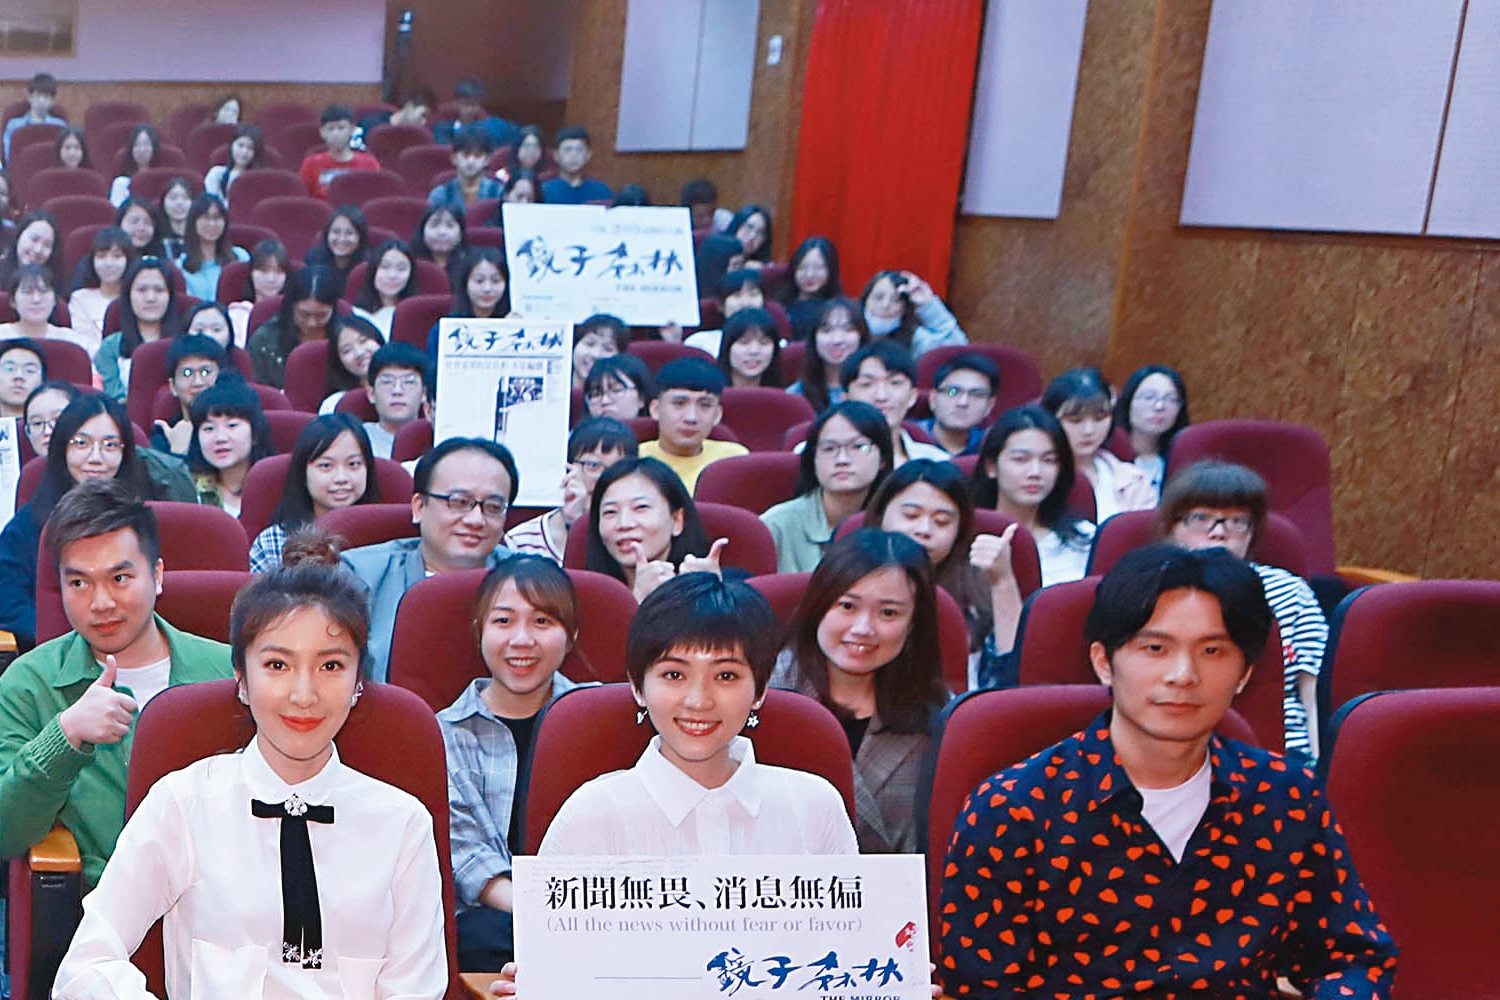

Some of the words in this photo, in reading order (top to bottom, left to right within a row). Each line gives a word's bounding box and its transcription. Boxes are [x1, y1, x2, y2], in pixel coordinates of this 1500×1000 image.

[516, 234, 684, 283] 鏡子森林
[545, 874, 864, 912] 新聞無畏、消息無偏
[547, 916, 578, 933] (All
[585, 917, 612, 932] the
[619, 919, 663, 932] news
[669, 917, 736, 932] without
[743, 917, 778, 932] fear
[783, 920, 803, 932] or
[809, 917, 862, 933] favor)
[706, 946, 905, 998] 鏡子森林
